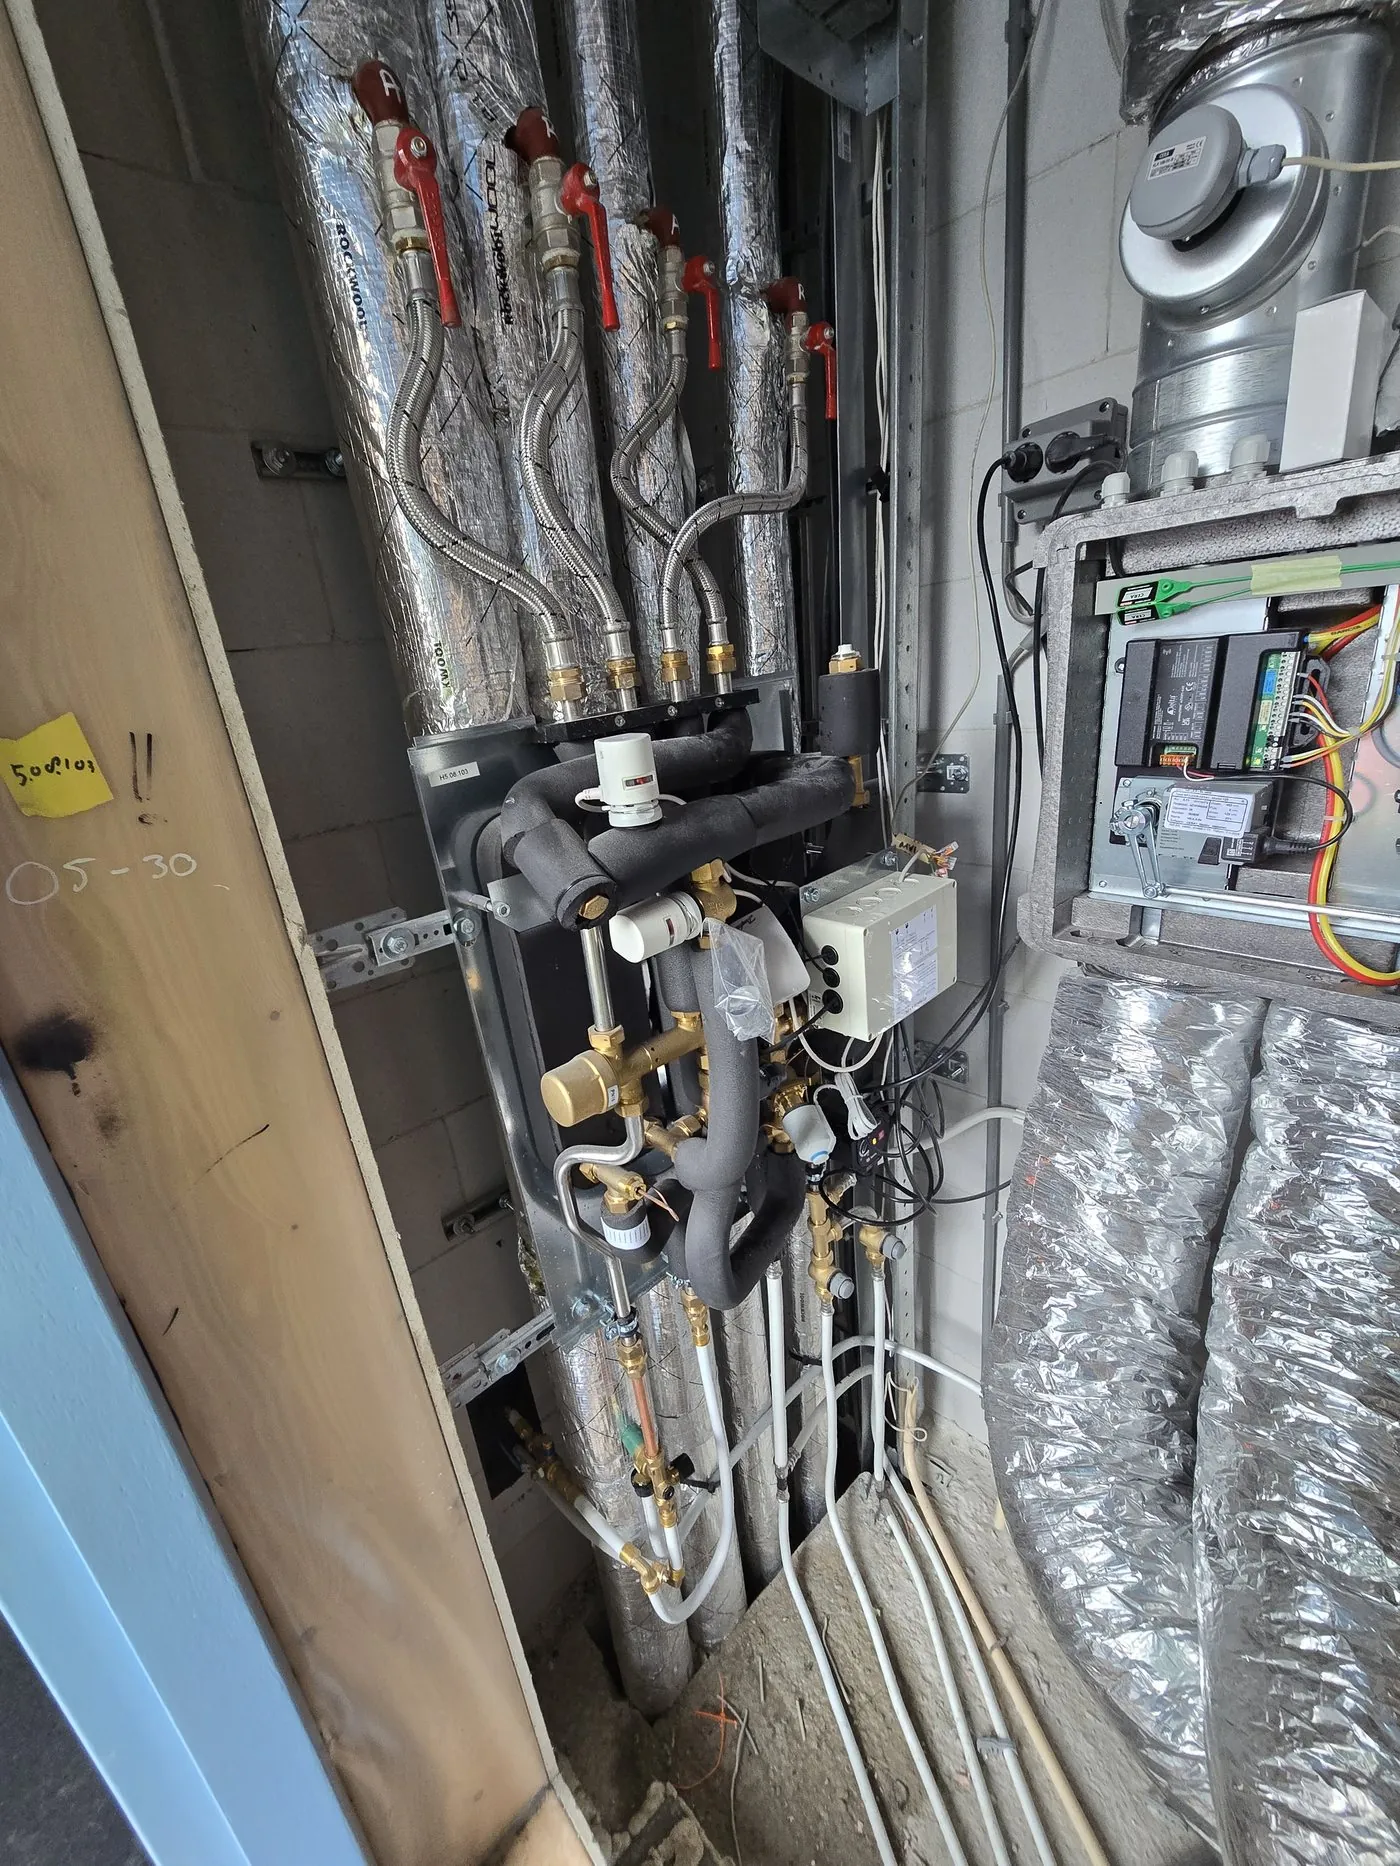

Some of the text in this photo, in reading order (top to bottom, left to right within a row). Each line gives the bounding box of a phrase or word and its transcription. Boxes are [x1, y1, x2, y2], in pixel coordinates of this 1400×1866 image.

[379, 69, 401, 103] A
[335, 221, 368, 332] ROCKWOOL
[797, 283, 806, 301] R
